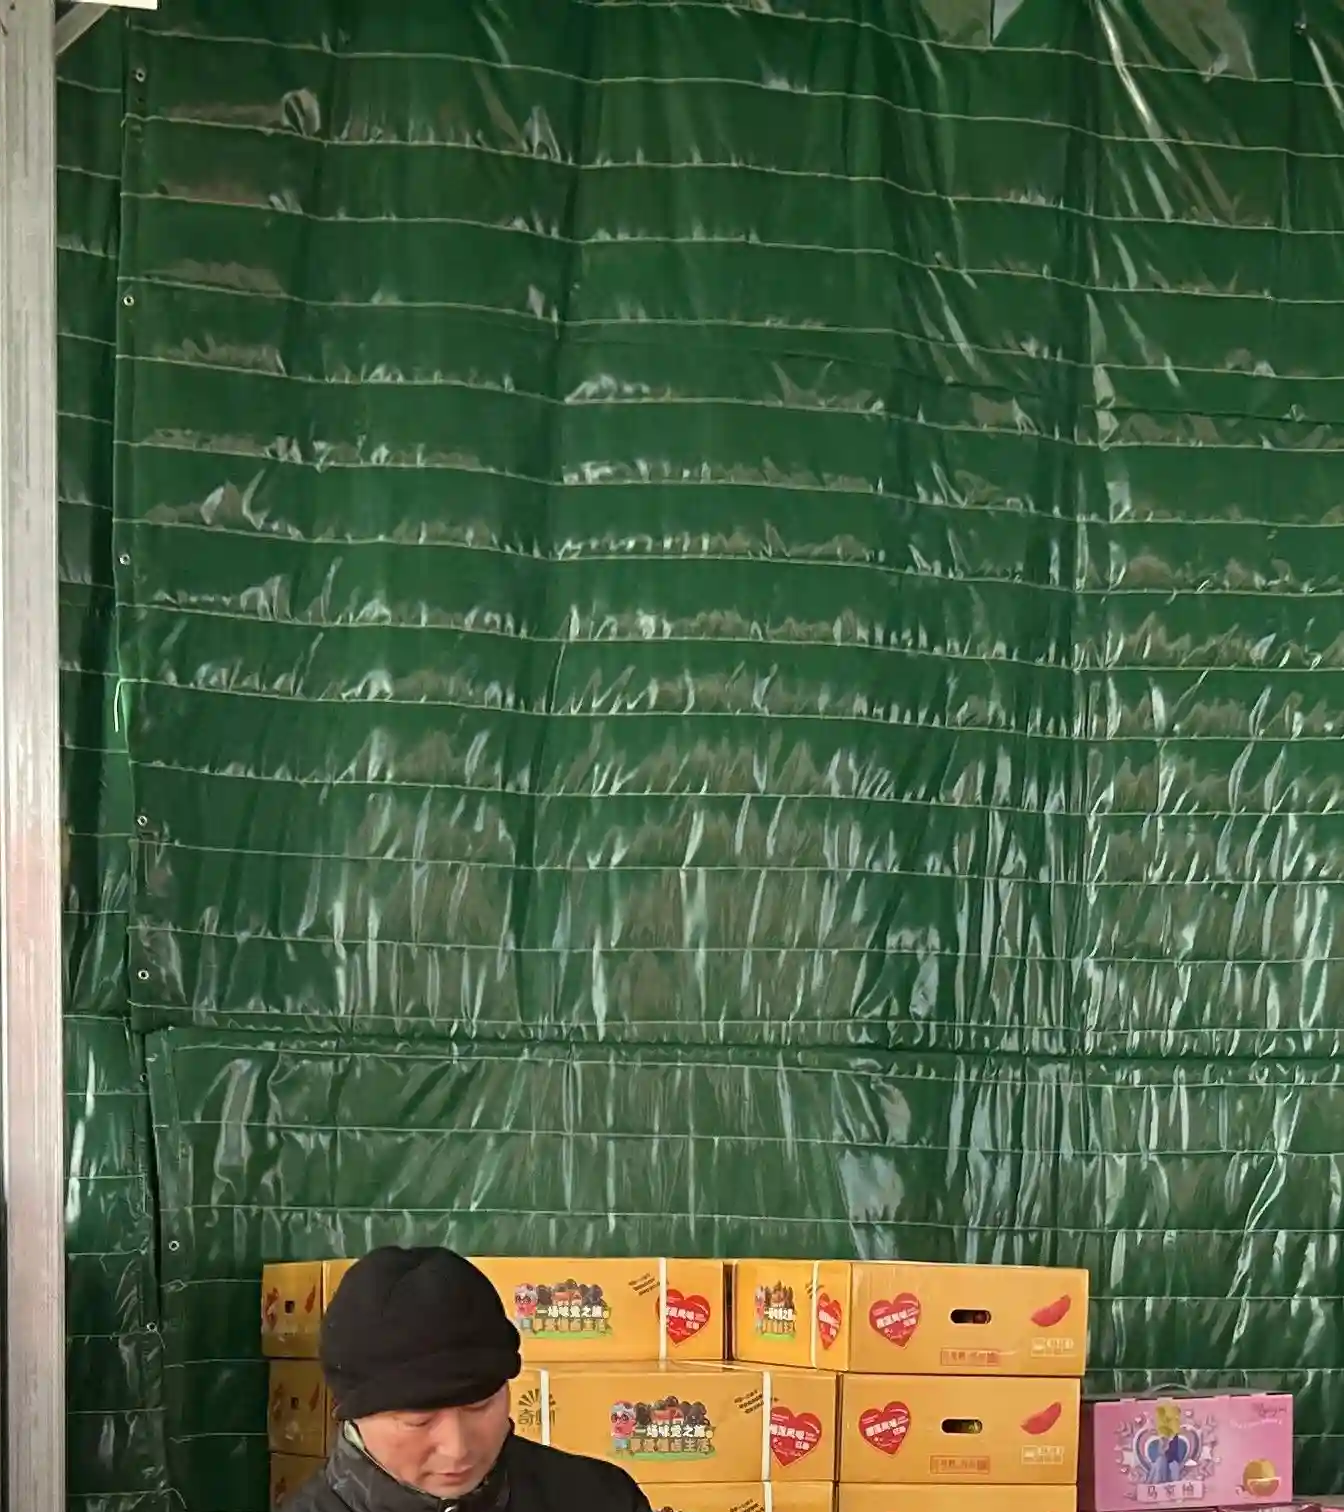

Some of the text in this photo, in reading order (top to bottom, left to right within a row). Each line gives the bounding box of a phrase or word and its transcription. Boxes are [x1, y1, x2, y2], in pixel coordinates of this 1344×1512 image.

[635, 1424, 707, 1439] 一场味觉之旅
